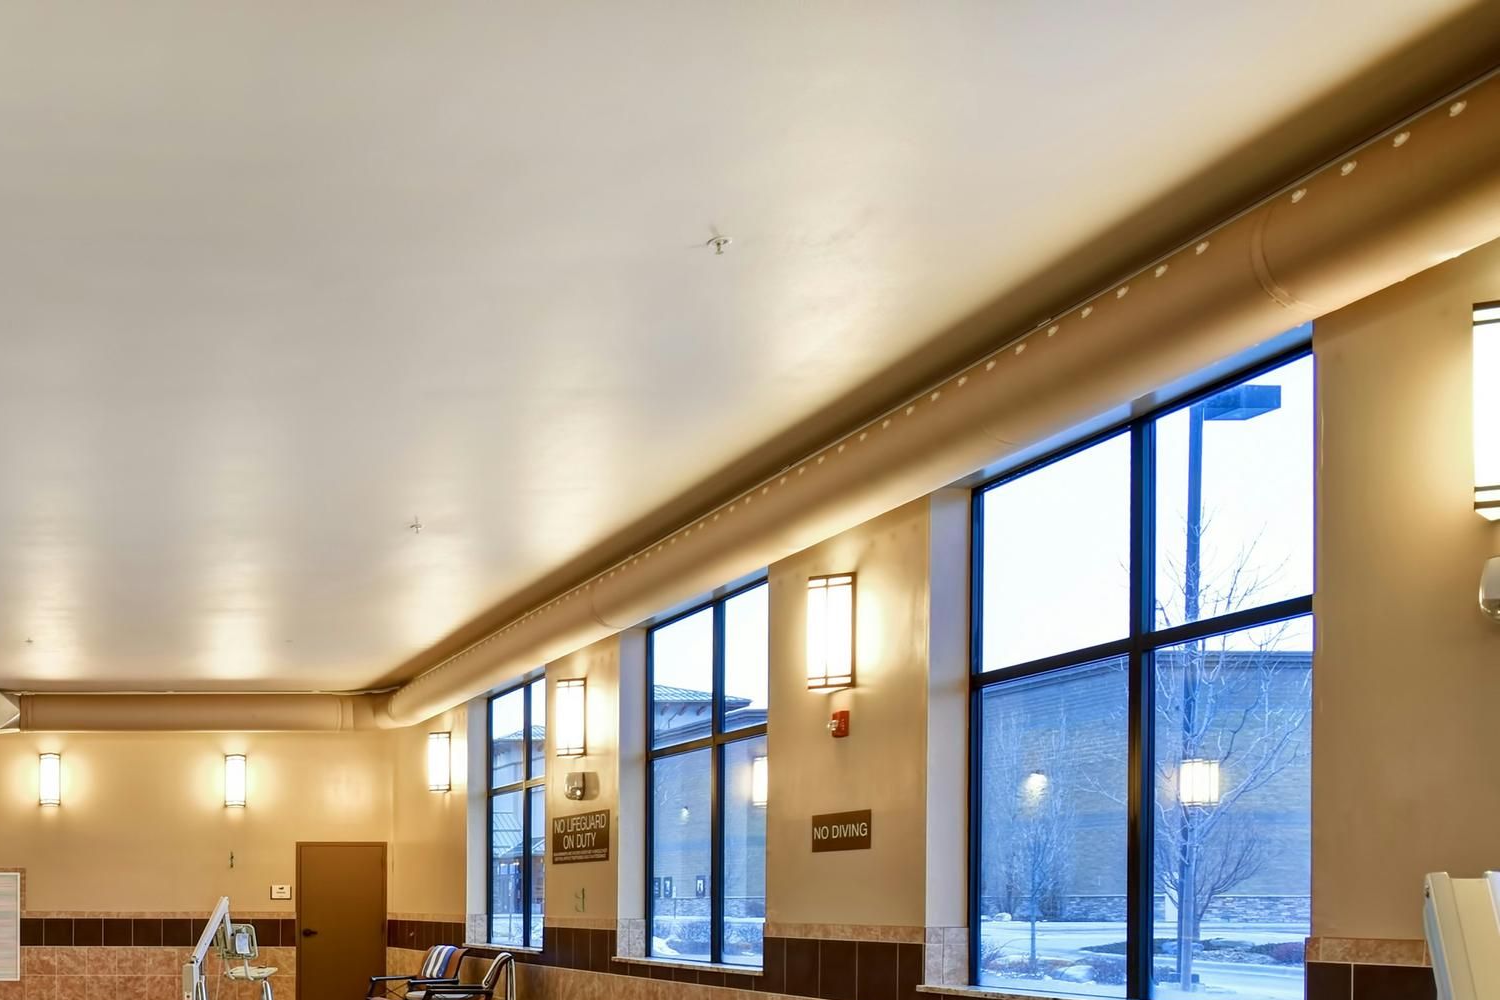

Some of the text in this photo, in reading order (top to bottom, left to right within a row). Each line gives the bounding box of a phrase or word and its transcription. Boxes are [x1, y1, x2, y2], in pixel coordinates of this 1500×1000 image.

[554, 813, 607, 834] NO LIFEGUARD
[813, 822, 868, 840] NO DIVING
[562, 832, 597, 850] ON DUTY
